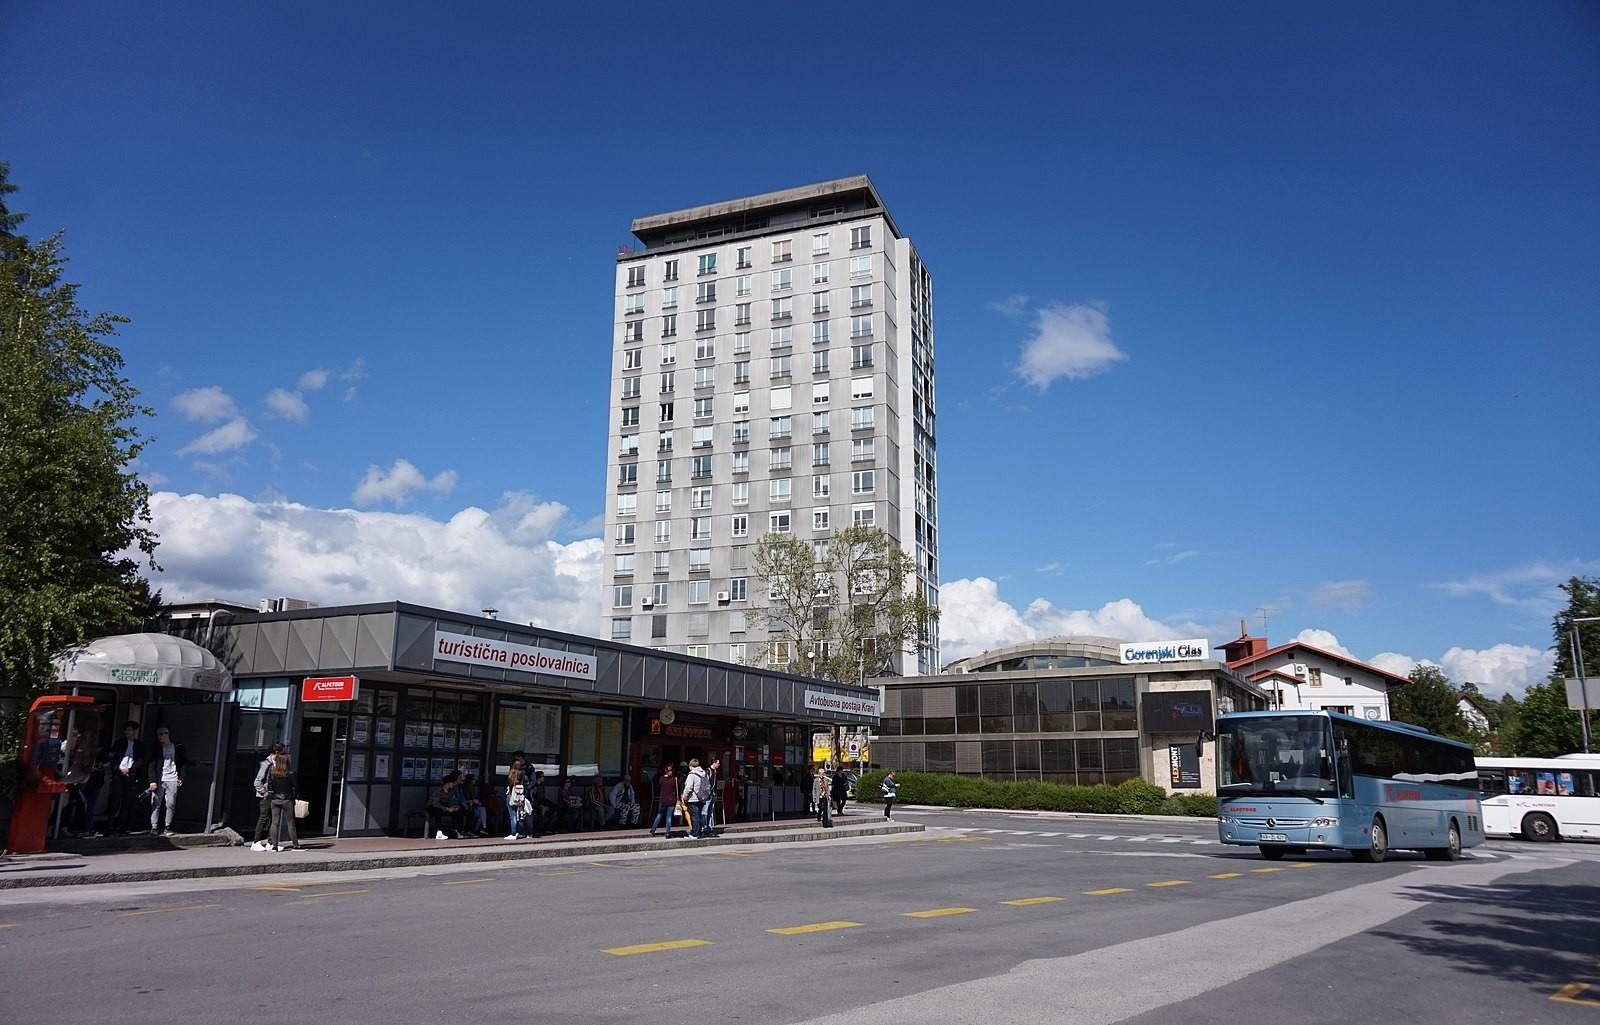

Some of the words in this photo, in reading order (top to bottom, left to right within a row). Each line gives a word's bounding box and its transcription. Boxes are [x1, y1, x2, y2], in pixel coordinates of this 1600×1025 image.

[438, 638, 507, 663] turistična
[511, 652, 590, 674] poslovalnica
[1125, 646, 1175, 661] Gorenjski
[1178, 645, 1202, 658] Glas
[809, 694, 840, 708] Avtobusna
[841, 700, 861, 712] postaja
[861, 703, 876, 715] Kranj
